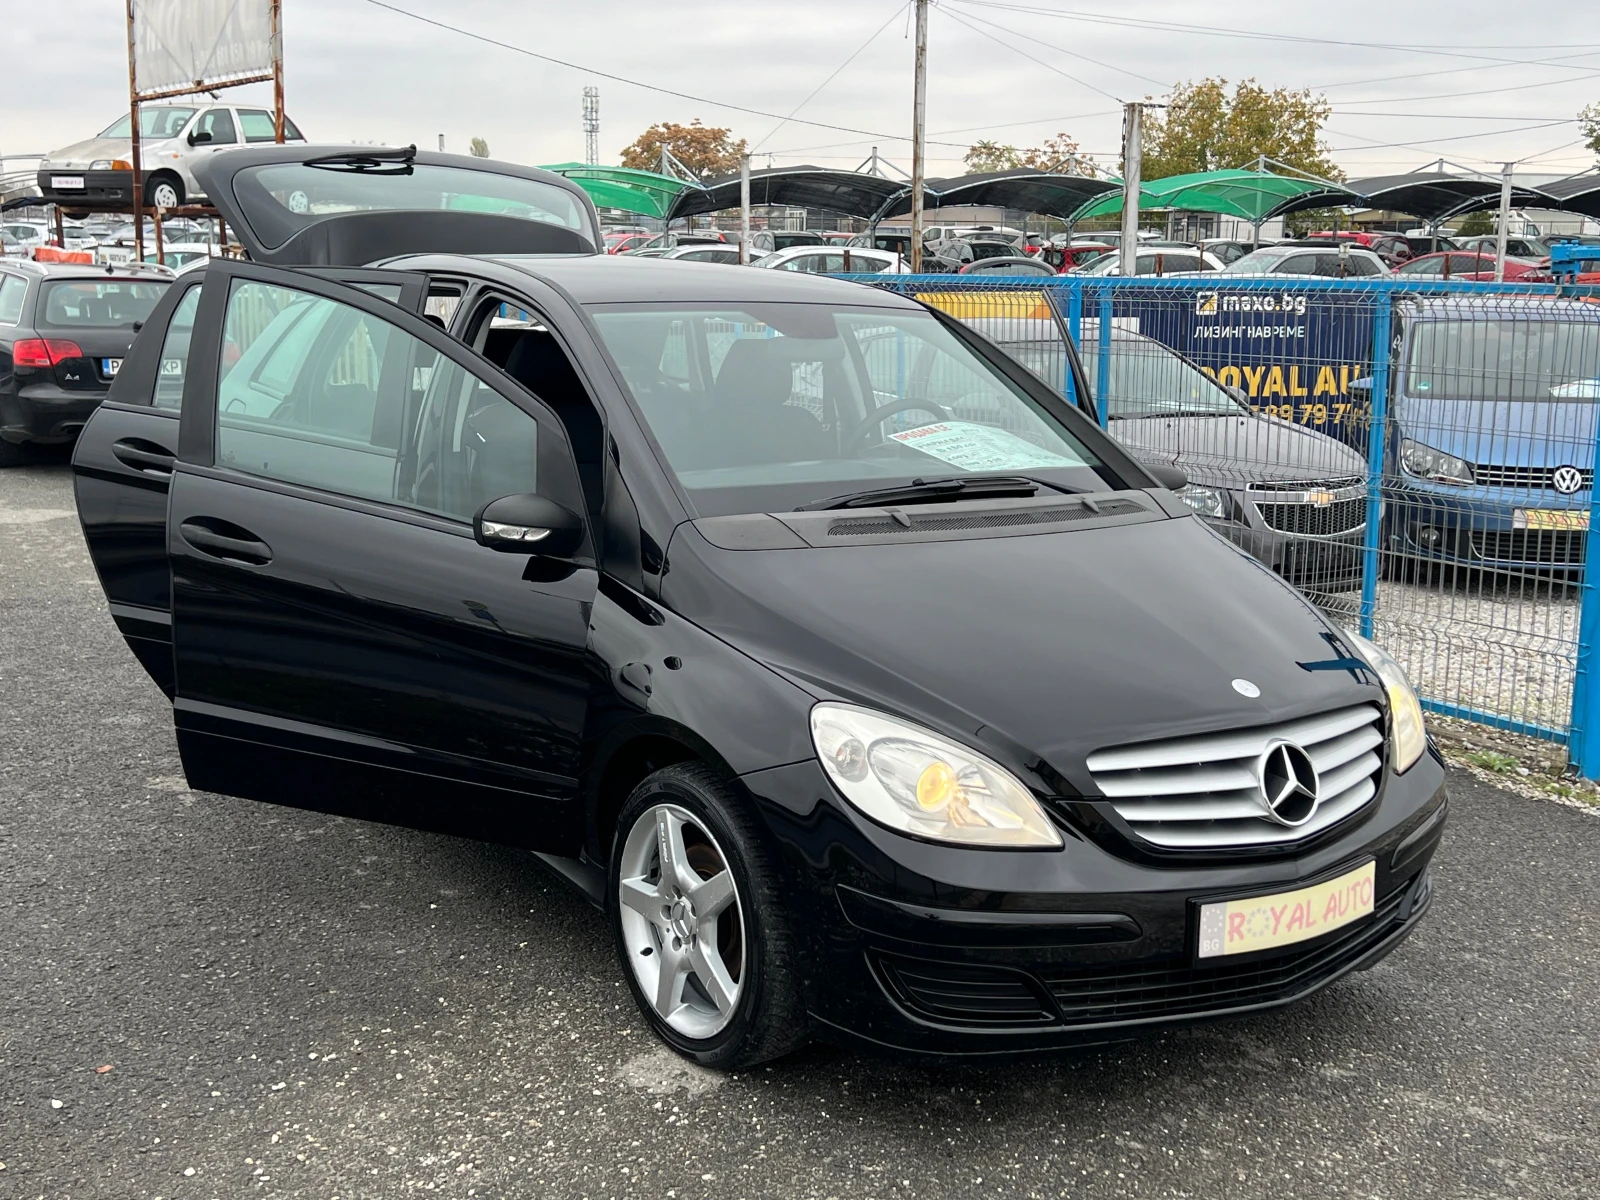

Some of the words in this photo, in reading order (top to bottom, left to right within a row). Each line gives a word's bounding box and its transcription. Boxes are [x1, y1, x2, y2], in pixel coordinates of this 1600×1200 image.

[1222, 293, 1306, 315] maxo.bg
[1194, 326, 1246, 338] ЛИЗИНГ
[1247, 326, 1305, 338] НАВРЕМЕ
[65, 373, 80, 381] A4
[1299, 404, 1327, 425] 79
[1228, 899, 1317, 943] ROYAL
[1323, 876, 1373, 923] AUTO
[1203, 938, 1220, 952] BG
